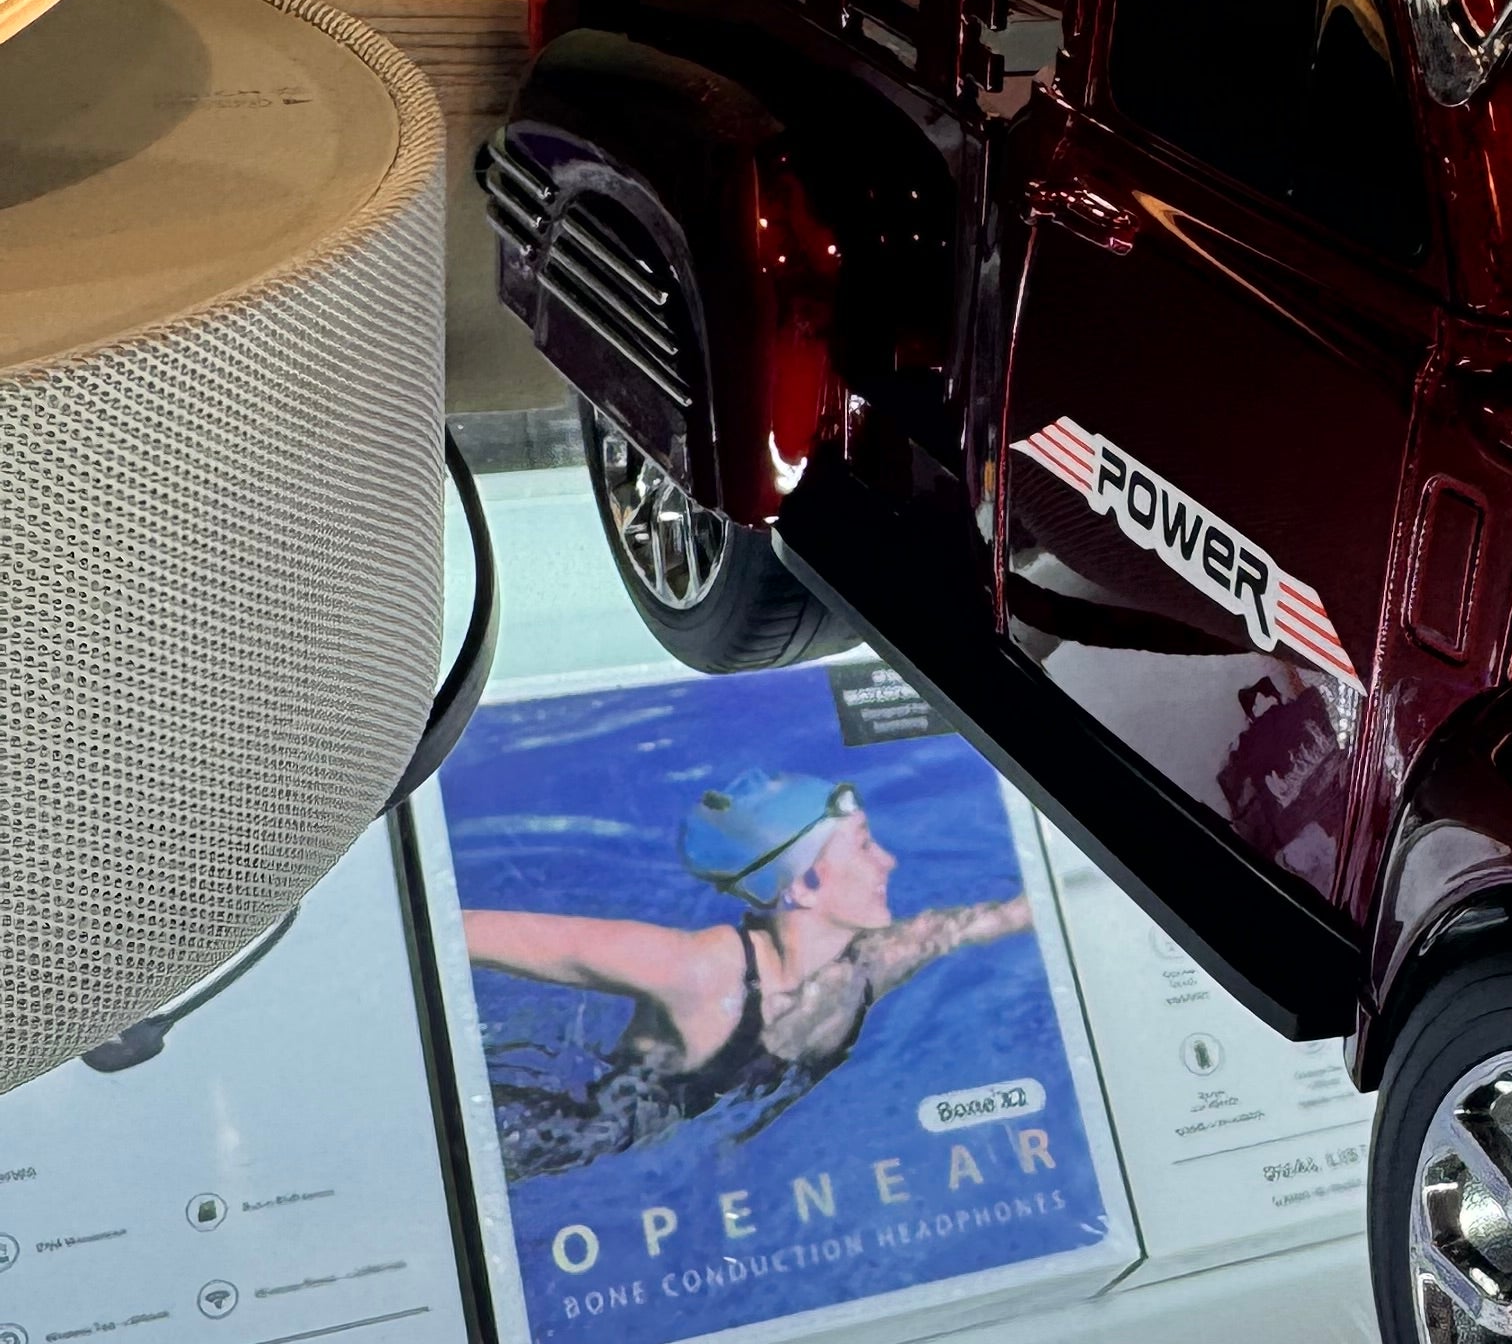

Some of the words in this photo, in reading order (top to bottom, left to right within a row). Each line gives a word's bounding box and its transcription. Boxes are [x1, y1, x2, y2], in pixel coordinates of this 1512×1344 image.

[564, 1280, 645, 1319] BONE
[662, 1232, 864, 1297] CONDUCTION
[877, 1190, 1066, 1248] HEADPHONES
